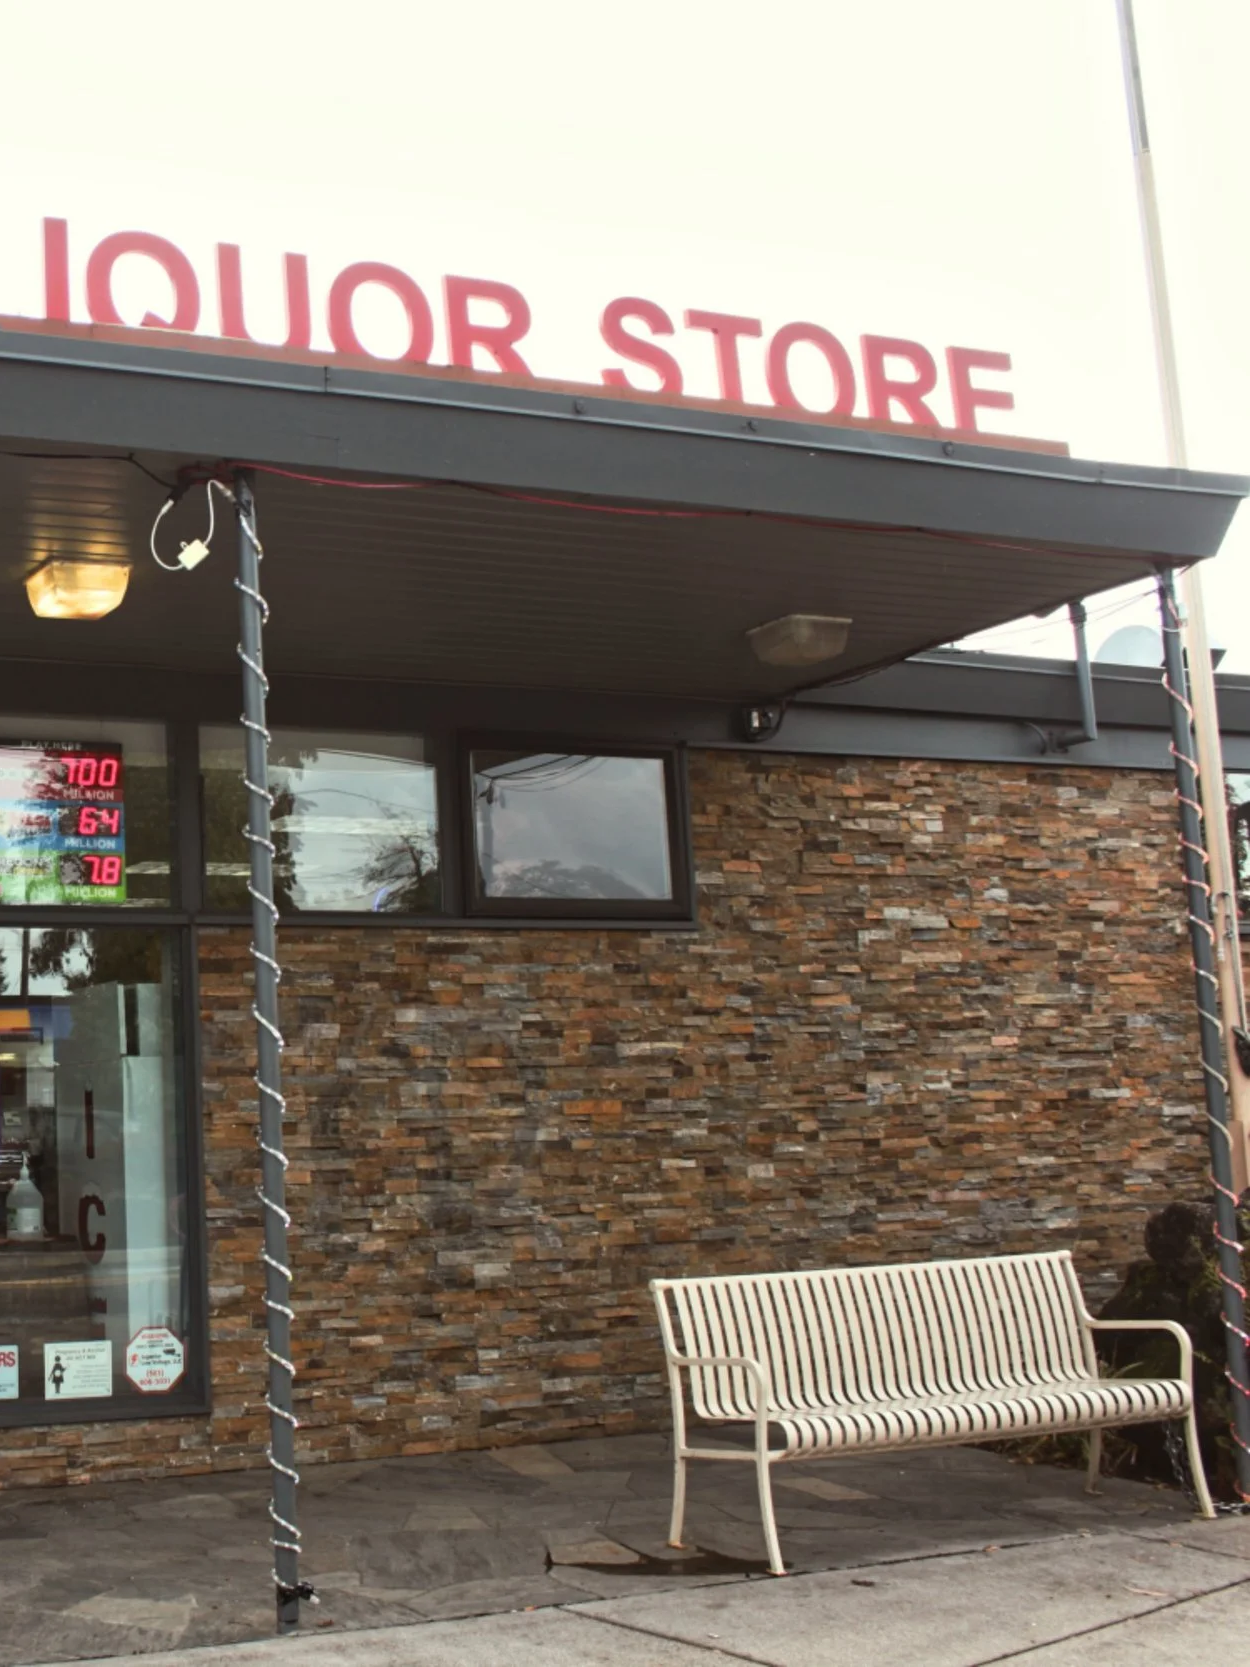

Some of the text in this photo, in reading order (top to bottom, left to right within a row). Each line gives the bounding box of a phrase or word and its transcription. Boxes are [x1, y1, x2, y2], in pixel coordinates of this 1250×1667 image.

[598, 296, 1016, 433] STORE
[60, 757, 118, 787] 700
[78, 806, 120, 836] 64
[64, 838, 116, 849] MILLION
[64, 886, 117, 898] MILLION
